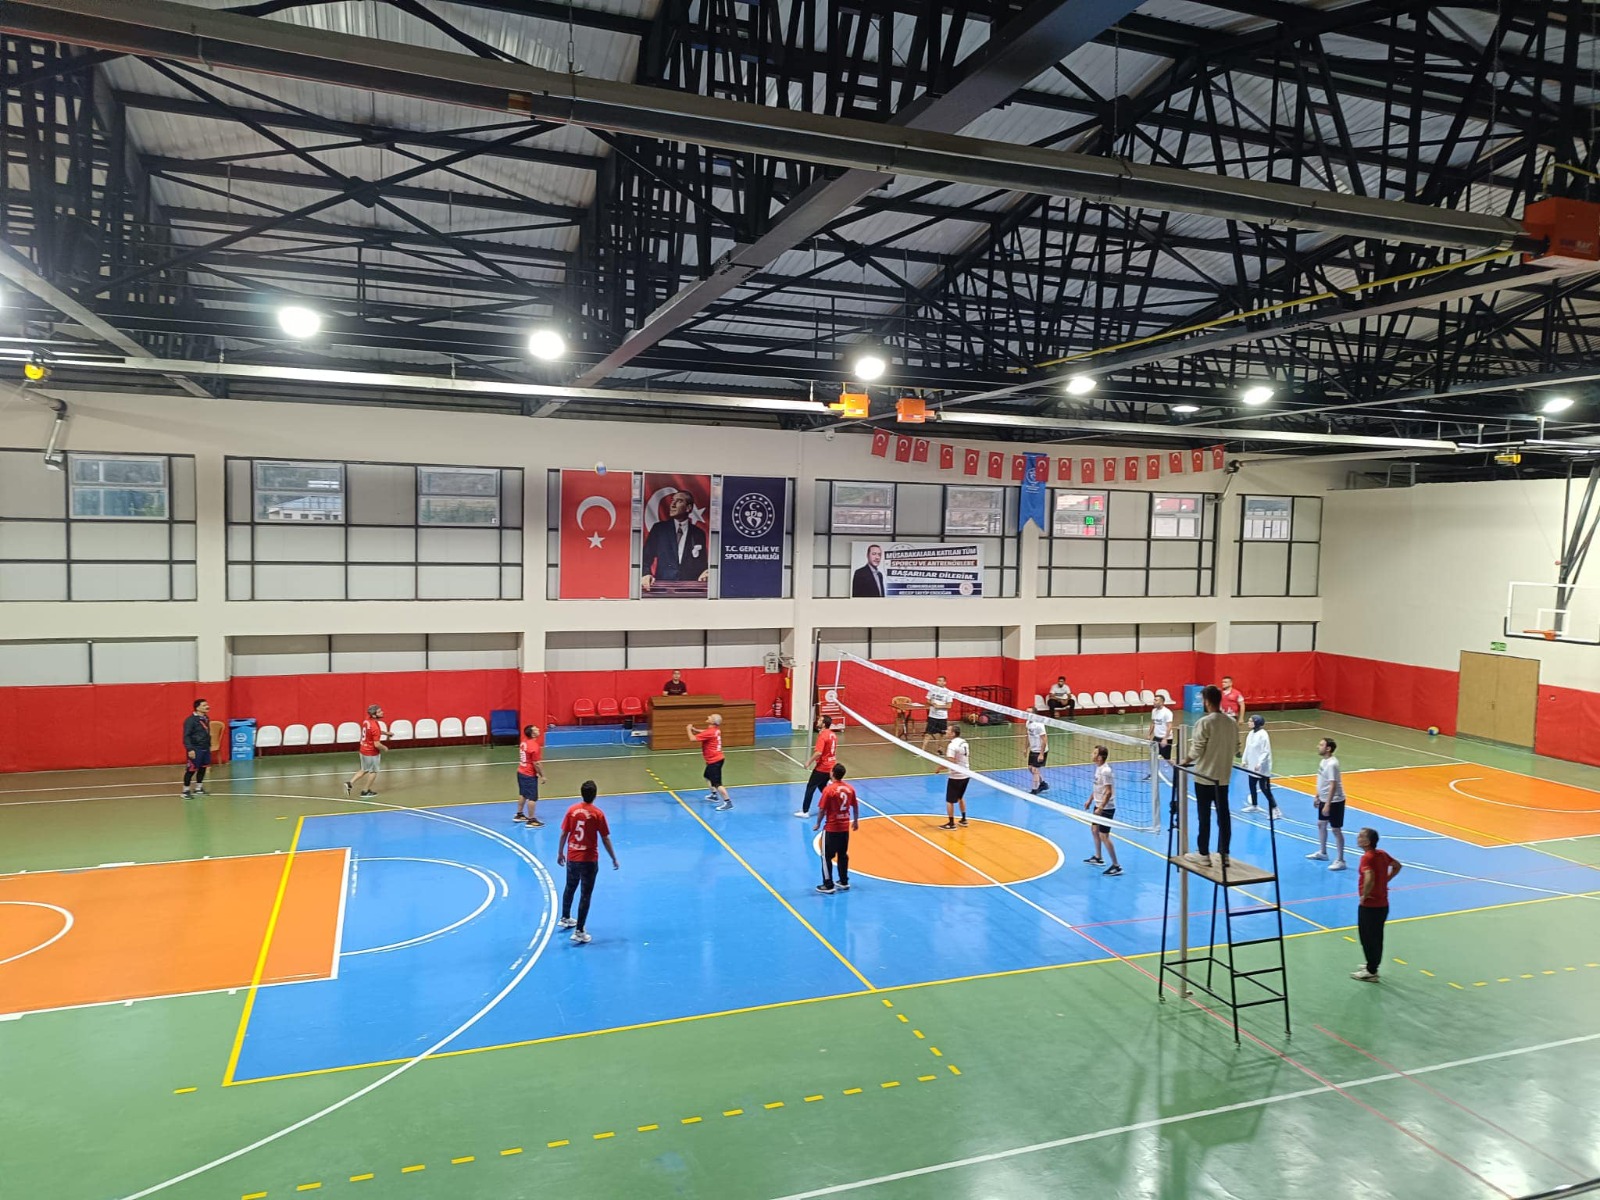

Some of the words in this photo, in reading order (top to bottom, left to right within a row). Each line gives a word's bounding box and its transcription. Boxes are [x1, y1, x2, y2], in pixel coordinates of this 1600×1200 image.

[739, 545, 769, 553] GENÇLİK
[962, 547, 976, 555] TÜM
[891, 570, 937, 578] BAŞARILAR
[840, 791, 848, 811] 2
[574, 820, 585, 842] 5
